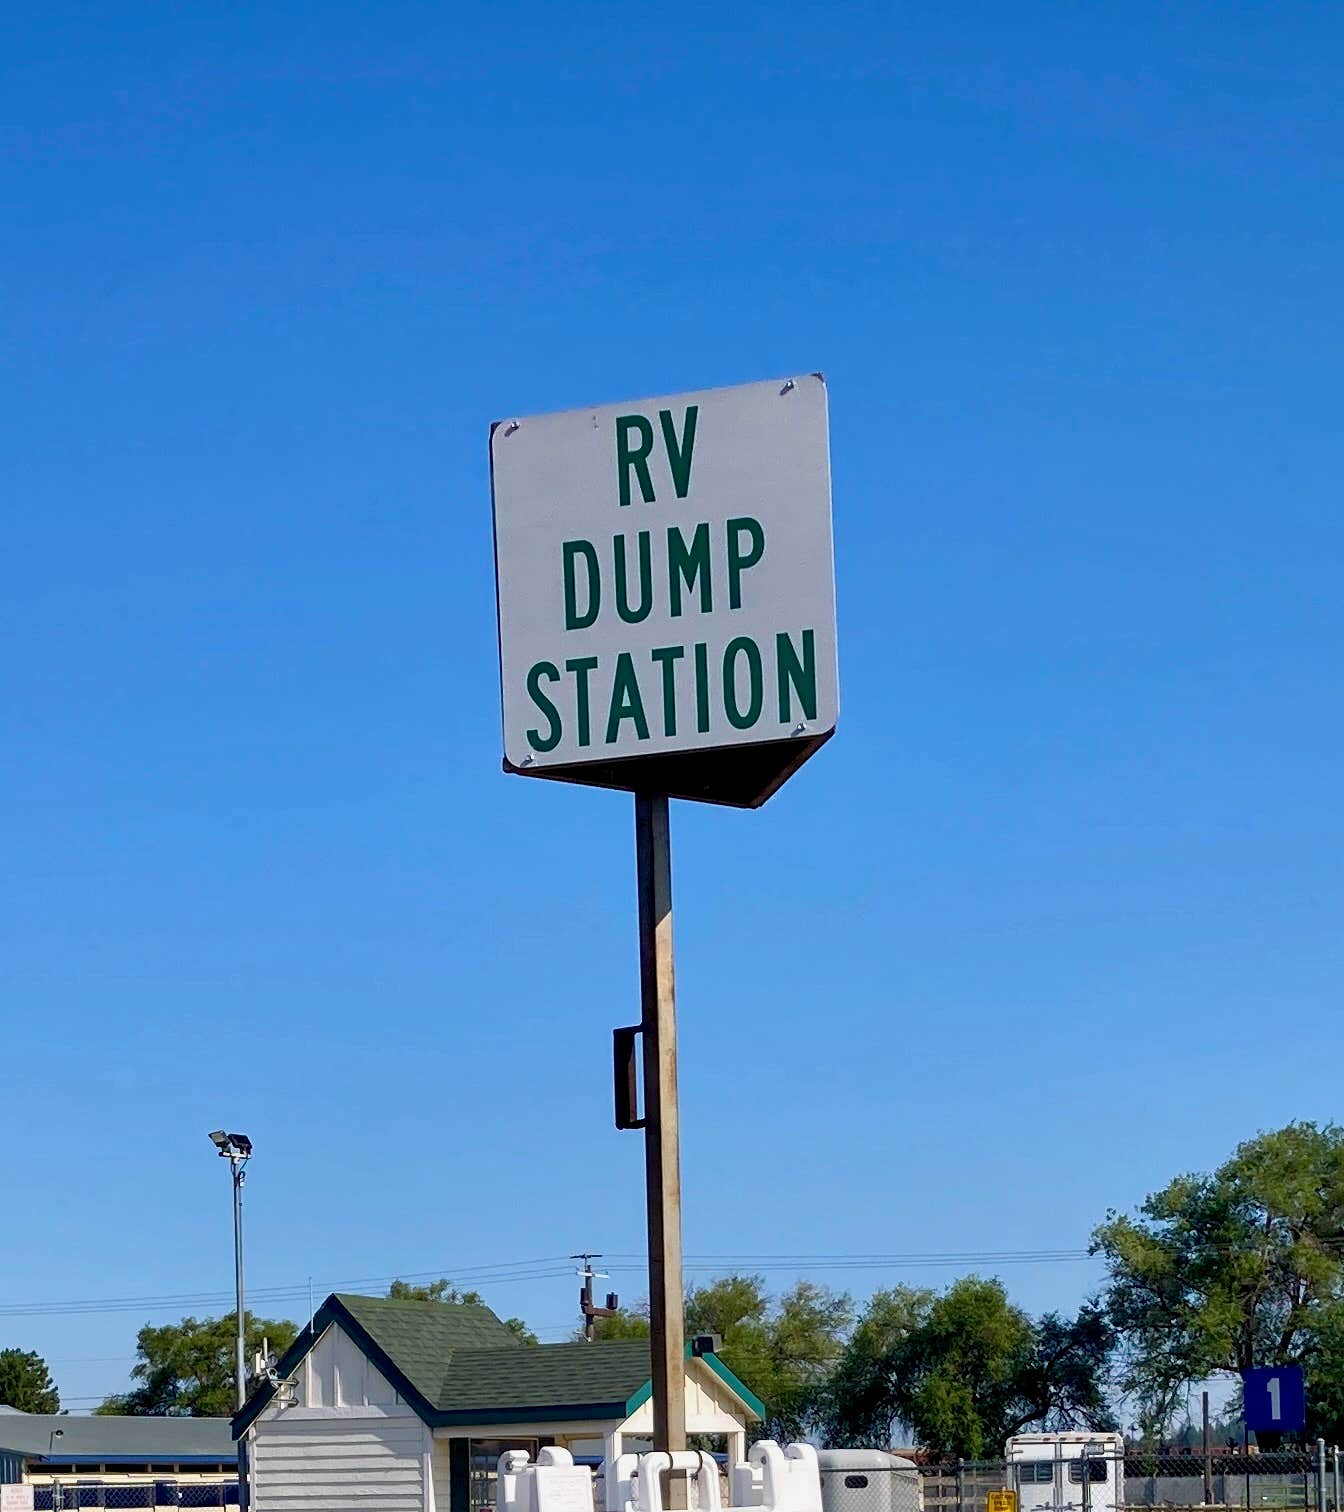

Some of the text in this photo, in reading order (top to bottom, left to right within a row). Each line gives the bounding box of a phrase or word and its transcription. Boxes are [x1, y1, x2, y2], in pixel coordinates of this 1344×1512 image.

[615, 405, 699, 506] RV
[562, 517, 765, 631] DUMP
[526, 629, 817, 753] STATION
[1266, 1377, 1281, 1420] 1
